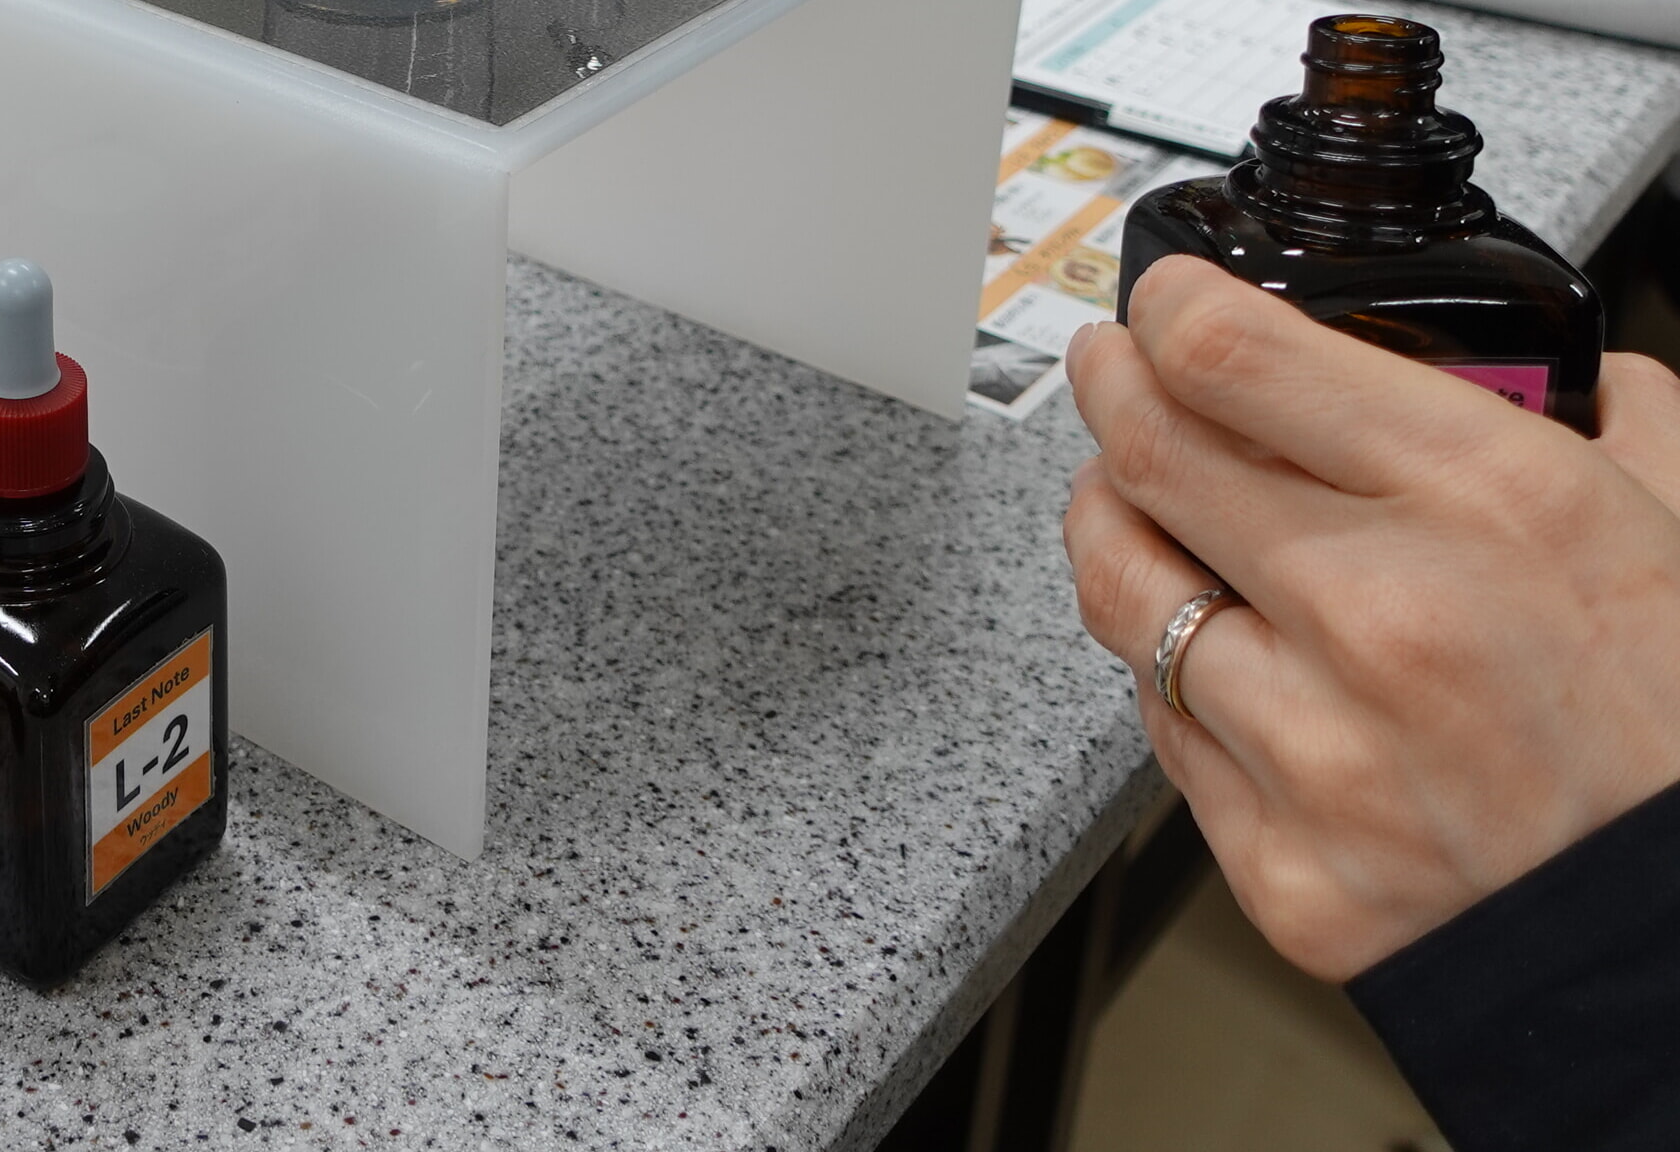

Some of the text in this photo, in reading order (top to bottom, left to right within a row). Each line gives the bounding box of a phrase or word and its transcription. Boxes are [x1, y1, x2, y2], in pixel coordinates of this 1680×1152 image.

[113, 666, 191, 736] Last Note
[115, 714, 190, 814] L-2
[126, 787, 180, 839] Woody
